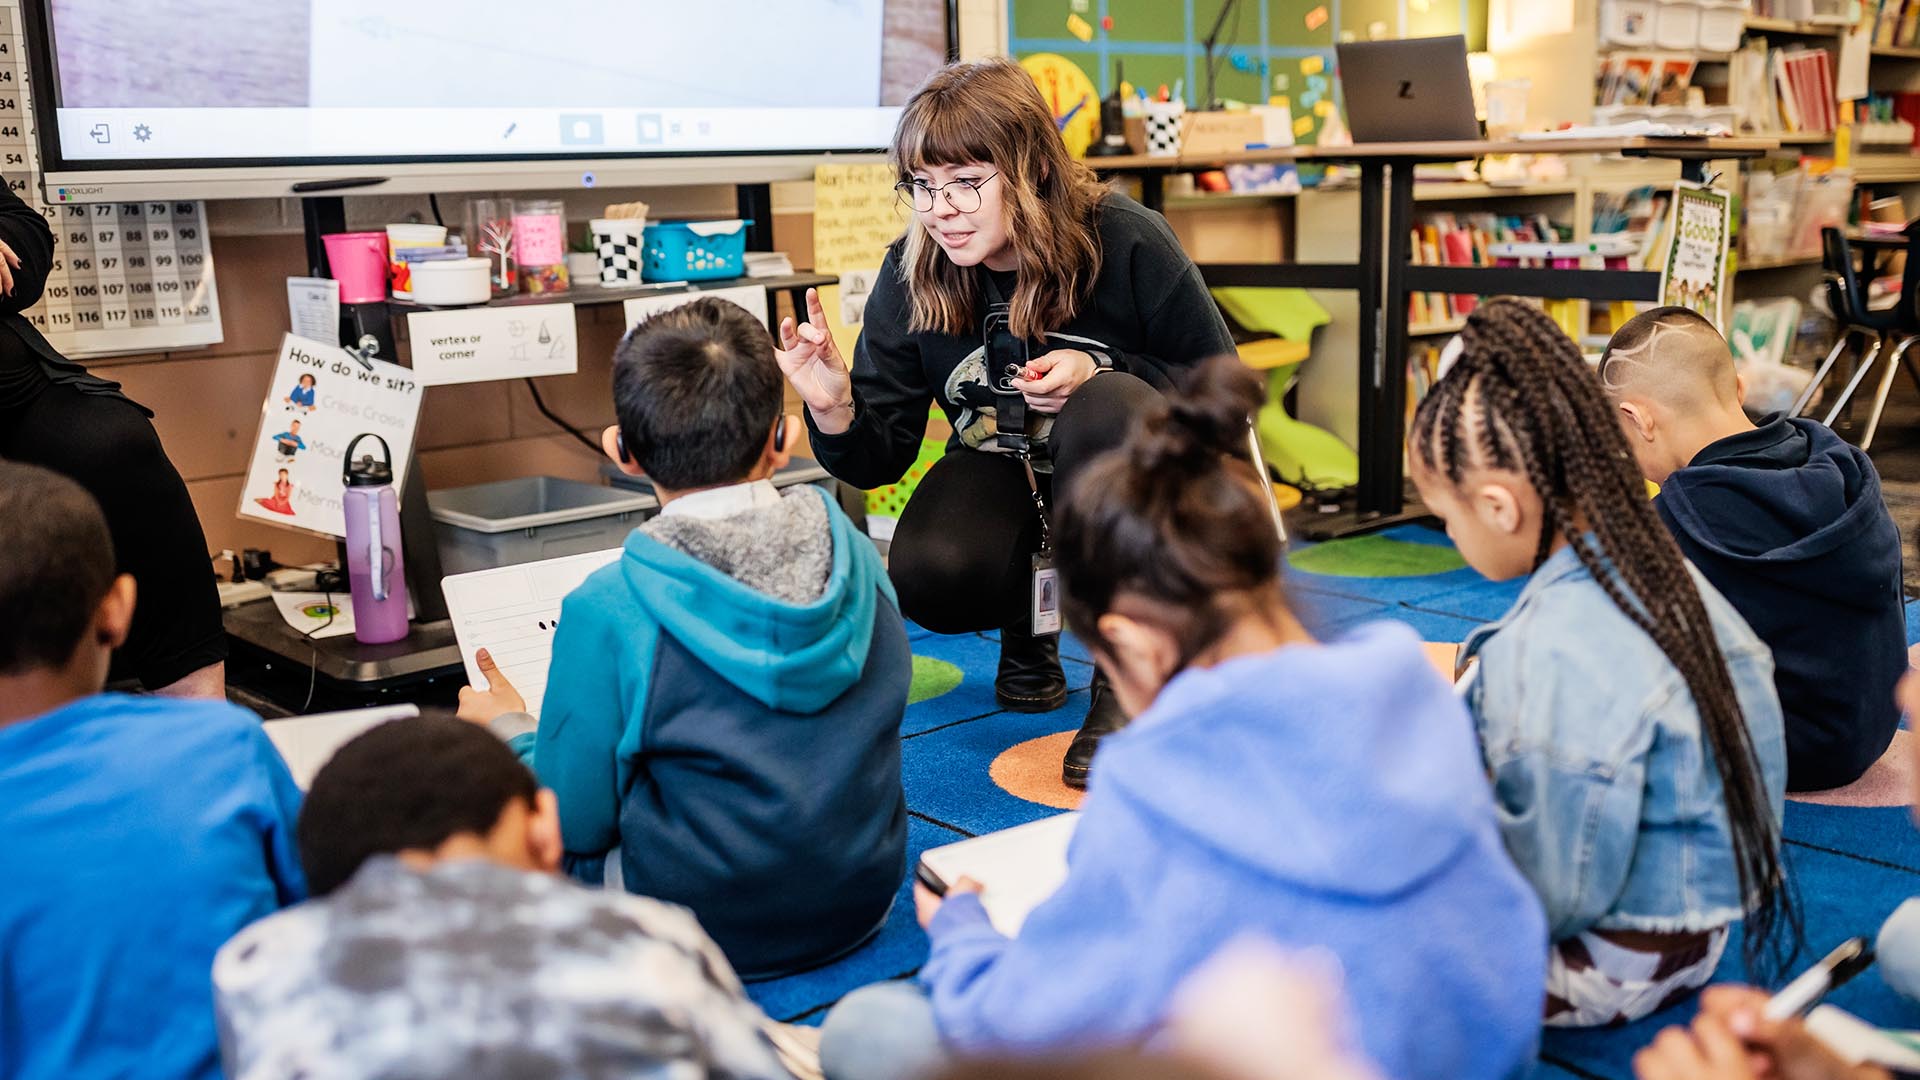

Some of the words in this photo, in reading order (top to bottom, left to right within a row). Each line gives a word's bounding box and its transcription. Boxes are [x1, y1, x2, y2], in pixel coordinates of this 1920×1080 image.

[1, 126, 19, 137] 44
[6, 153, 23, 164] 54
[9, 180, 26, 191] 64
[65, 187, 103, 195] BOXLIGHT
[41, 207, 56, 217] 75
[68, 206, 84, 217] 76
[95, 205, 111, 216] 77
[123, 204, 140, 216] 78
[151, 203, 166, 215] 79
[176, 203, 193, 215] 80
[70, 232, 87, 243] 86
[99, 231, 114, 243] 87
[126, 230, 142, 242] 88
[153, 229, 169, 241] 89
[179, 228, 196, 240] 90
[73, 259, 90, 270] 96
[101, 258, 117, 269] 97
[129, 256, 145, 268] 98
[155, 255, 172, 266] 99
[180, 254, 203, 266] 100
[48, 287, 69, 298] 105
[74, 286, 97, 297] 106
[103, 284, 124, 295] 107
[130, 283, 152, 294] 108
[157, 282, 179, 292] 109
[52, 314, 71, 324] 115
[78, 312, 99, 323] 116
[106, 310, 126, 321] 117
[133, 309, 155, 320] 118
[161, 307, 181, 318] 119
[430, 335, 466, 346] vertex
[470, 335, 481, 343] or
[439, 350, 475, 361] corner
[289, 347, 326, 369] How
[331, 361, 351, 376] do
[357, 370, 381, 385] we
[386, 378, 415, 395] sit?
[321, 394, 360, 417] Criss
[362, 404, 406, 430] Cross
